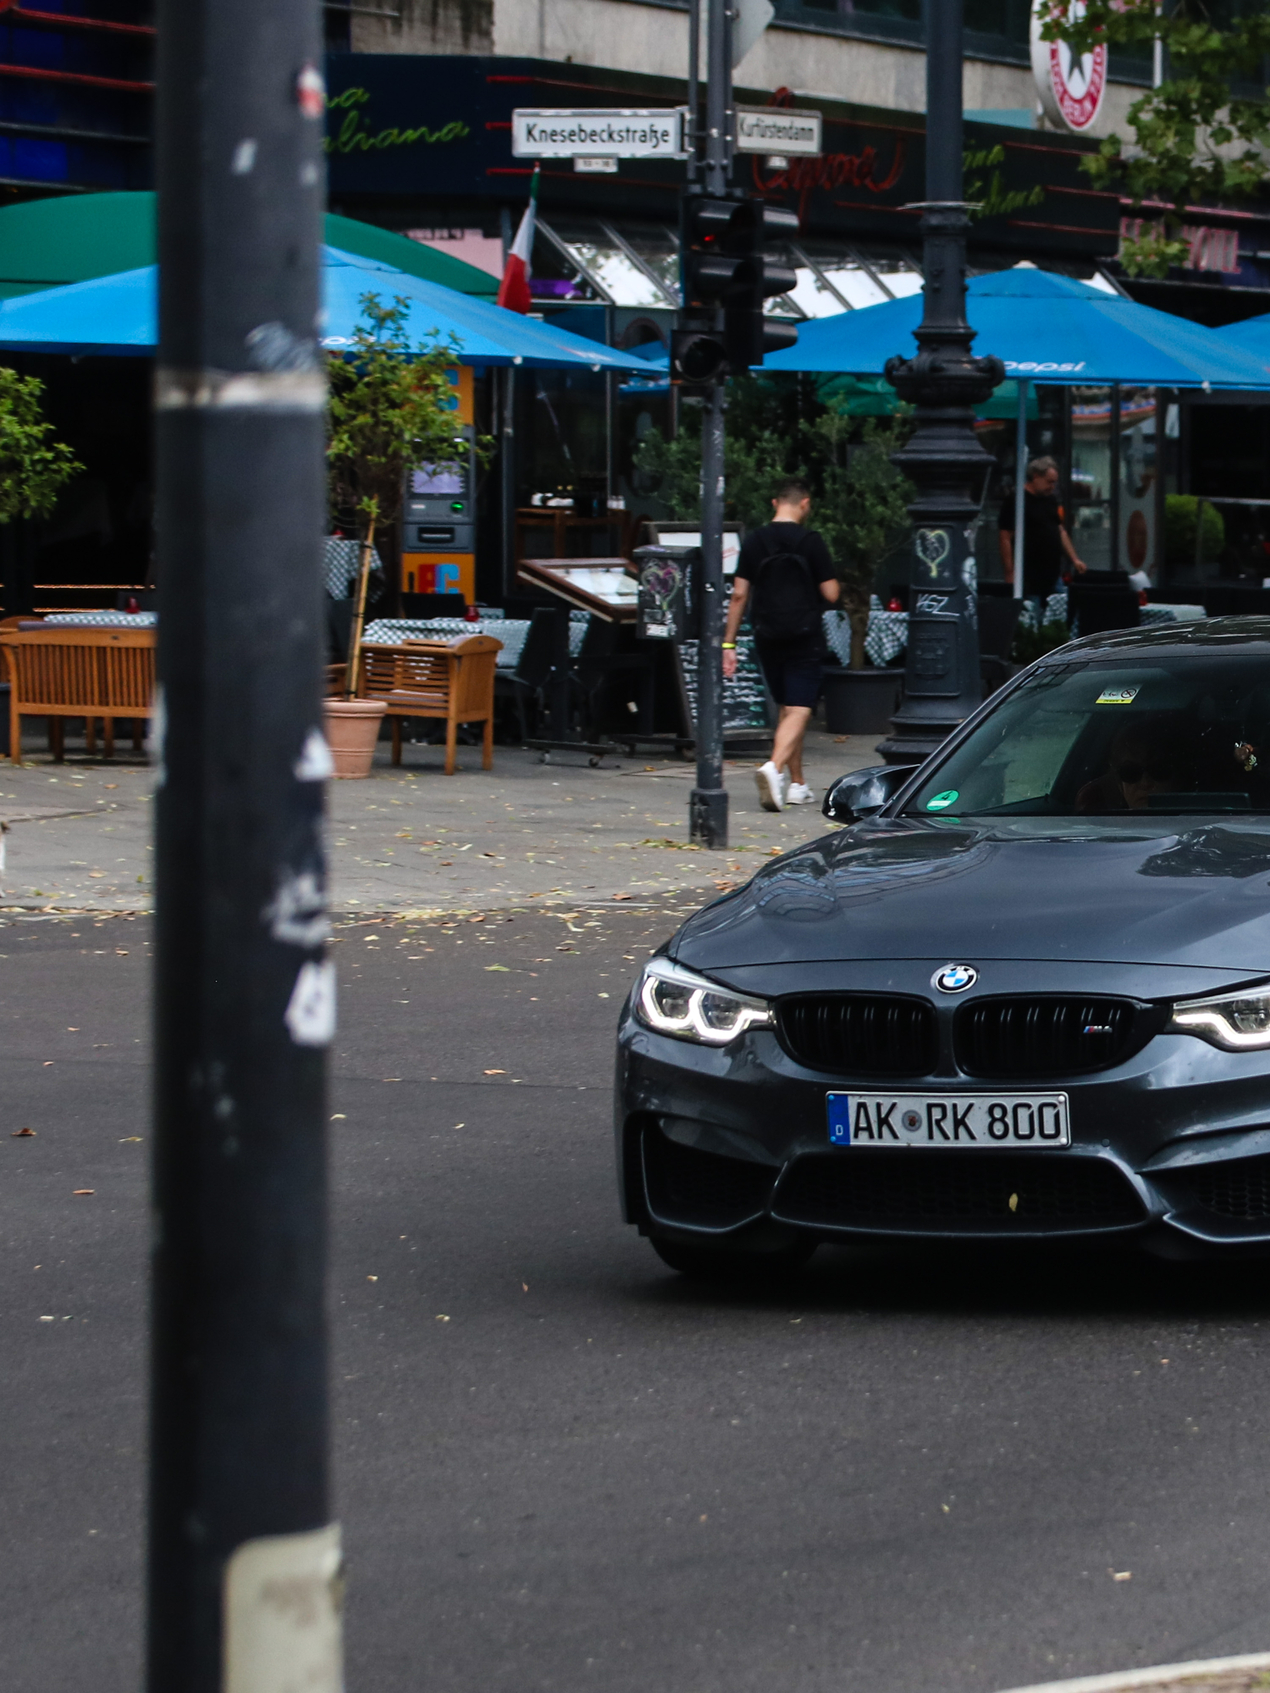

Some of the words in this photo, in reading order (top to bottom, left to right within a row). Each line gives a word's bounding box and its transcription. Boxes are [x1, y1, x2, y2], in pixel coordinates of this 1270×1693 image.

[526, 123, 670, 148] Knesebeckstraße
[738, 117, 815, 142] Kurfürstendamm
[853, 1102, 900, 1140] AK
[926, 1102, 978, 1141] RK
[987, 1102, 1062, 1140] 800
